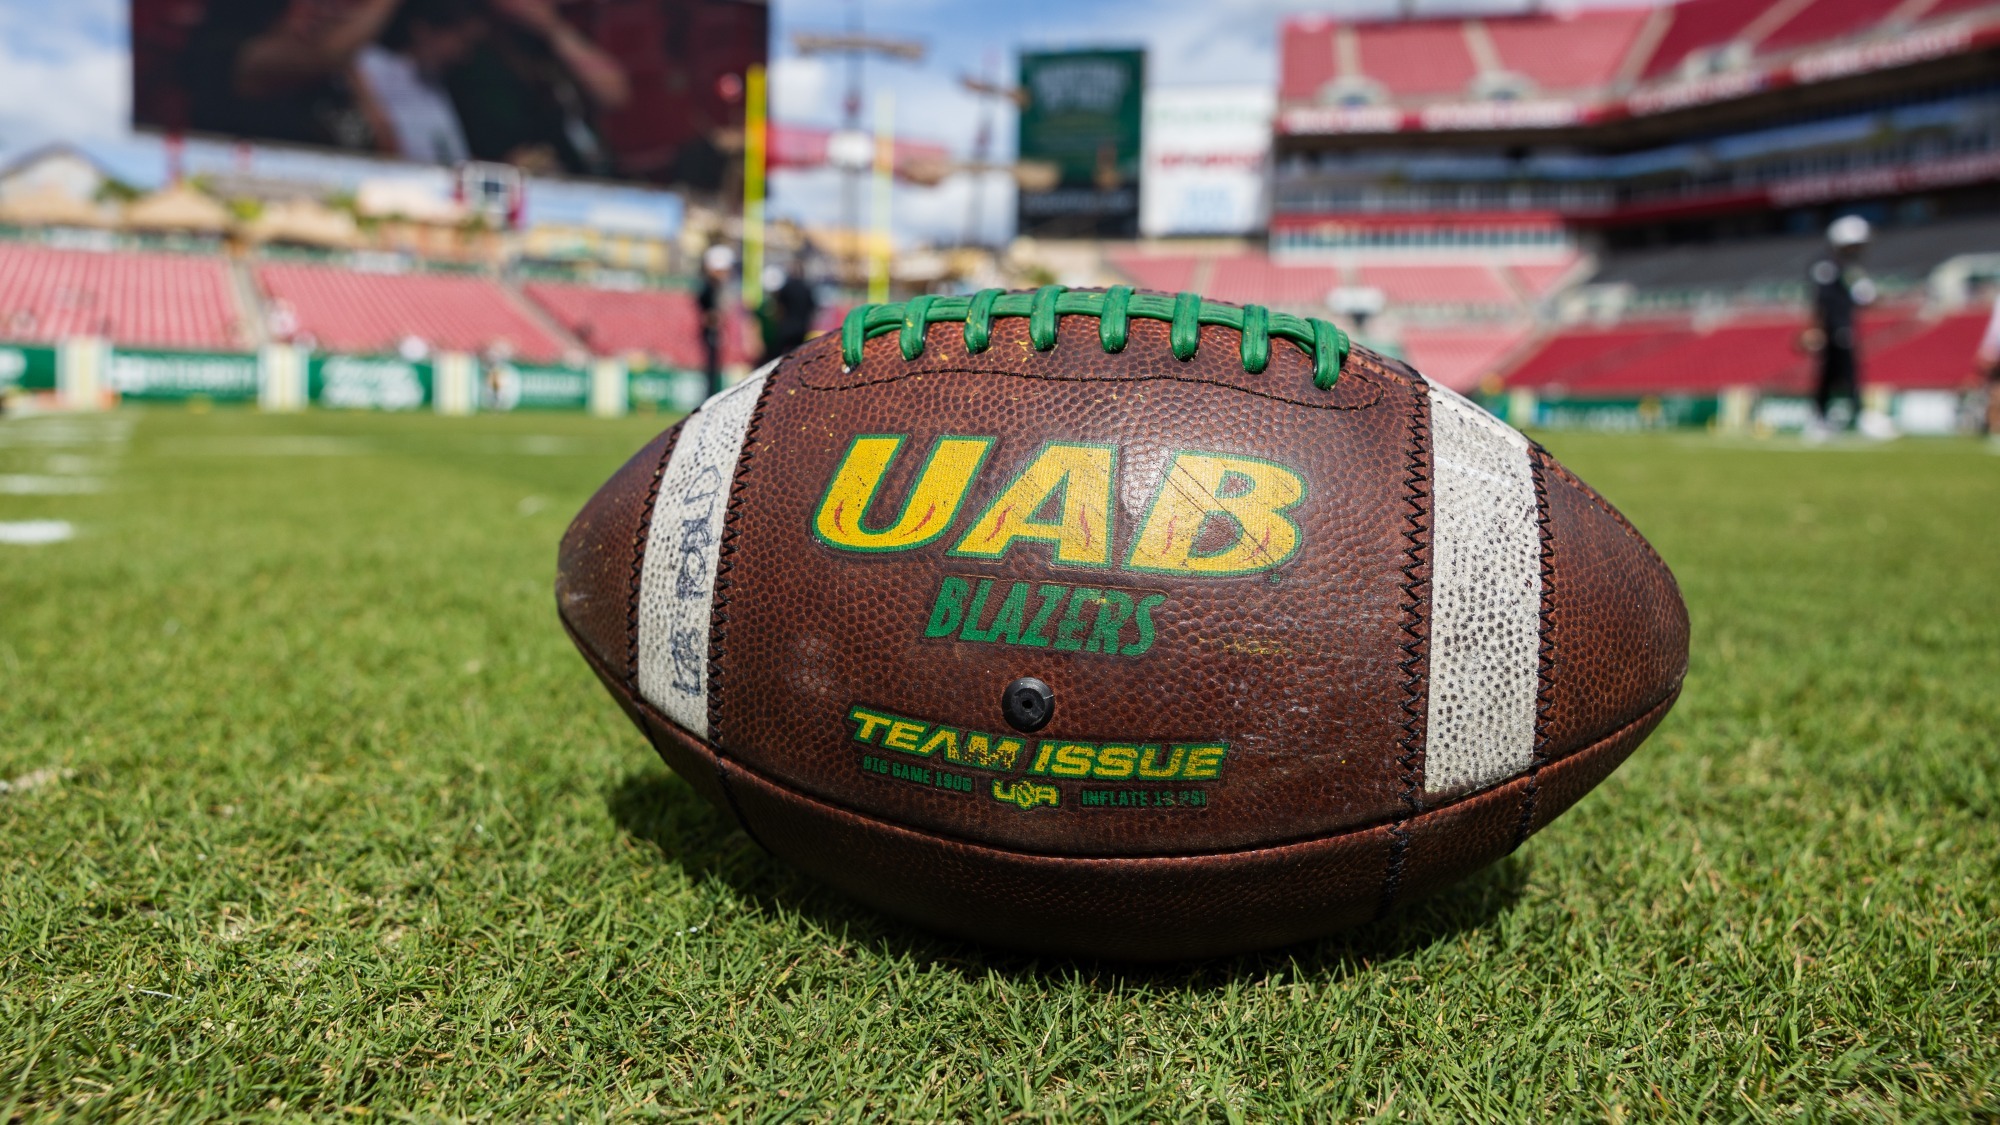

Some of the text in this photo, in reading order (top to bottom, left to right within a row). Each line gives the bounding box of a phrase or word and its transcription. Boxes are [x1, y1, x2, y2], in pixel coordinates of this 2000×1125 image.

[811, 434, 1309, 577] UAB
[923, 576, 1165, 656] BLAZERS
[849, 706, 1230, 780] TEAM ISSUE
[863, 755, 888, 775] BIG
[892, 763, 931, 785] GAME
[992, 778, 1060, 810] USA
[1081, 790, 1148, 807] INFLATE
[1178, 790, 1207, 807] PSI
